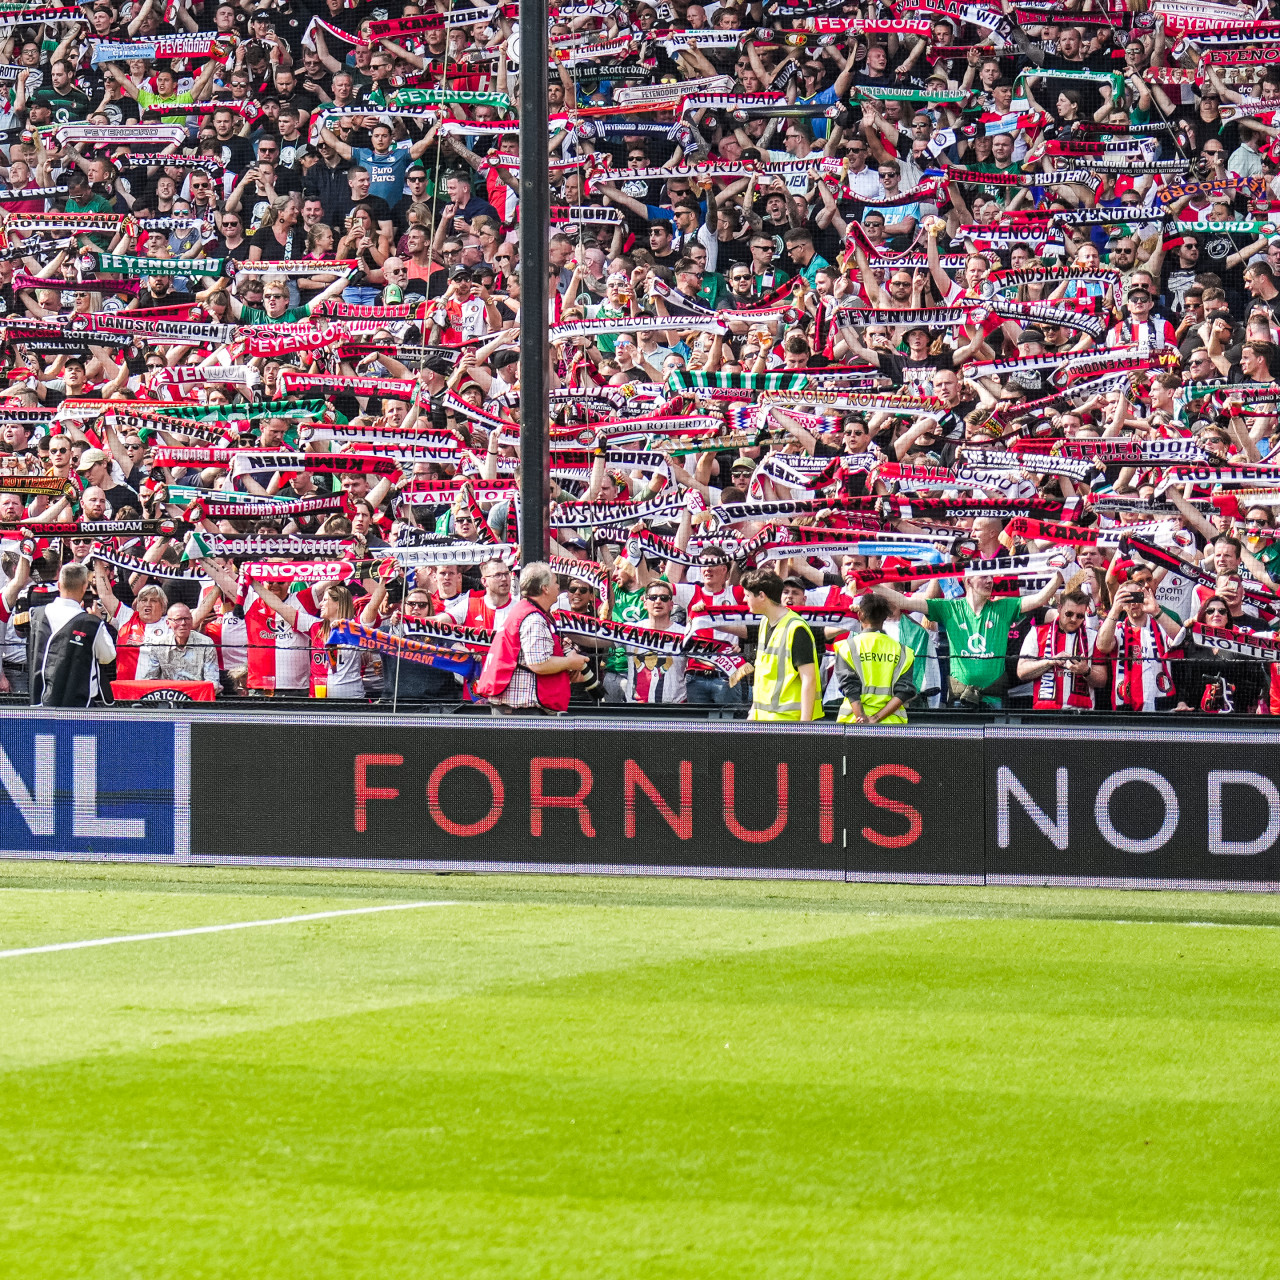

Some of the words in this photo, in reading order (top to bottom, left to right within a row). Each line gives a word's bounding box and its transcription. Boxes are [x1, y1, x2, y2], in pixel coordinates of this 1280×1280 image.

[1166, 15, 1254, 31] FEYENOORD
[159, 41, 212, 56] FEYENOORD
[688, 93, 779, 106] ROTTERDAM
[858, 87, 915, 99] FEYENOORD
[919, 88, 966, 100] ROTTERDAM
[102, 253, 218, 271] FEYENOORD
[97, 316, 219, 337] LANDSKAMPIOEN
[962, 450, 981, 464] THE
[984, 451, 1019, 466] FINAL
[1021, 454, 1092, 473] NIGHTMARE
[81, 521, 142, 532] ROTTERDAM
[208, 534, 342, 555] Rotterdam
[338, 620, 469, 663] FEYENOORD
[358, 637, 434, 666] ROTTERDAM
[860, 652, 899, 664] SERVICE
[354, 753, 922, 849] FORNUIS
